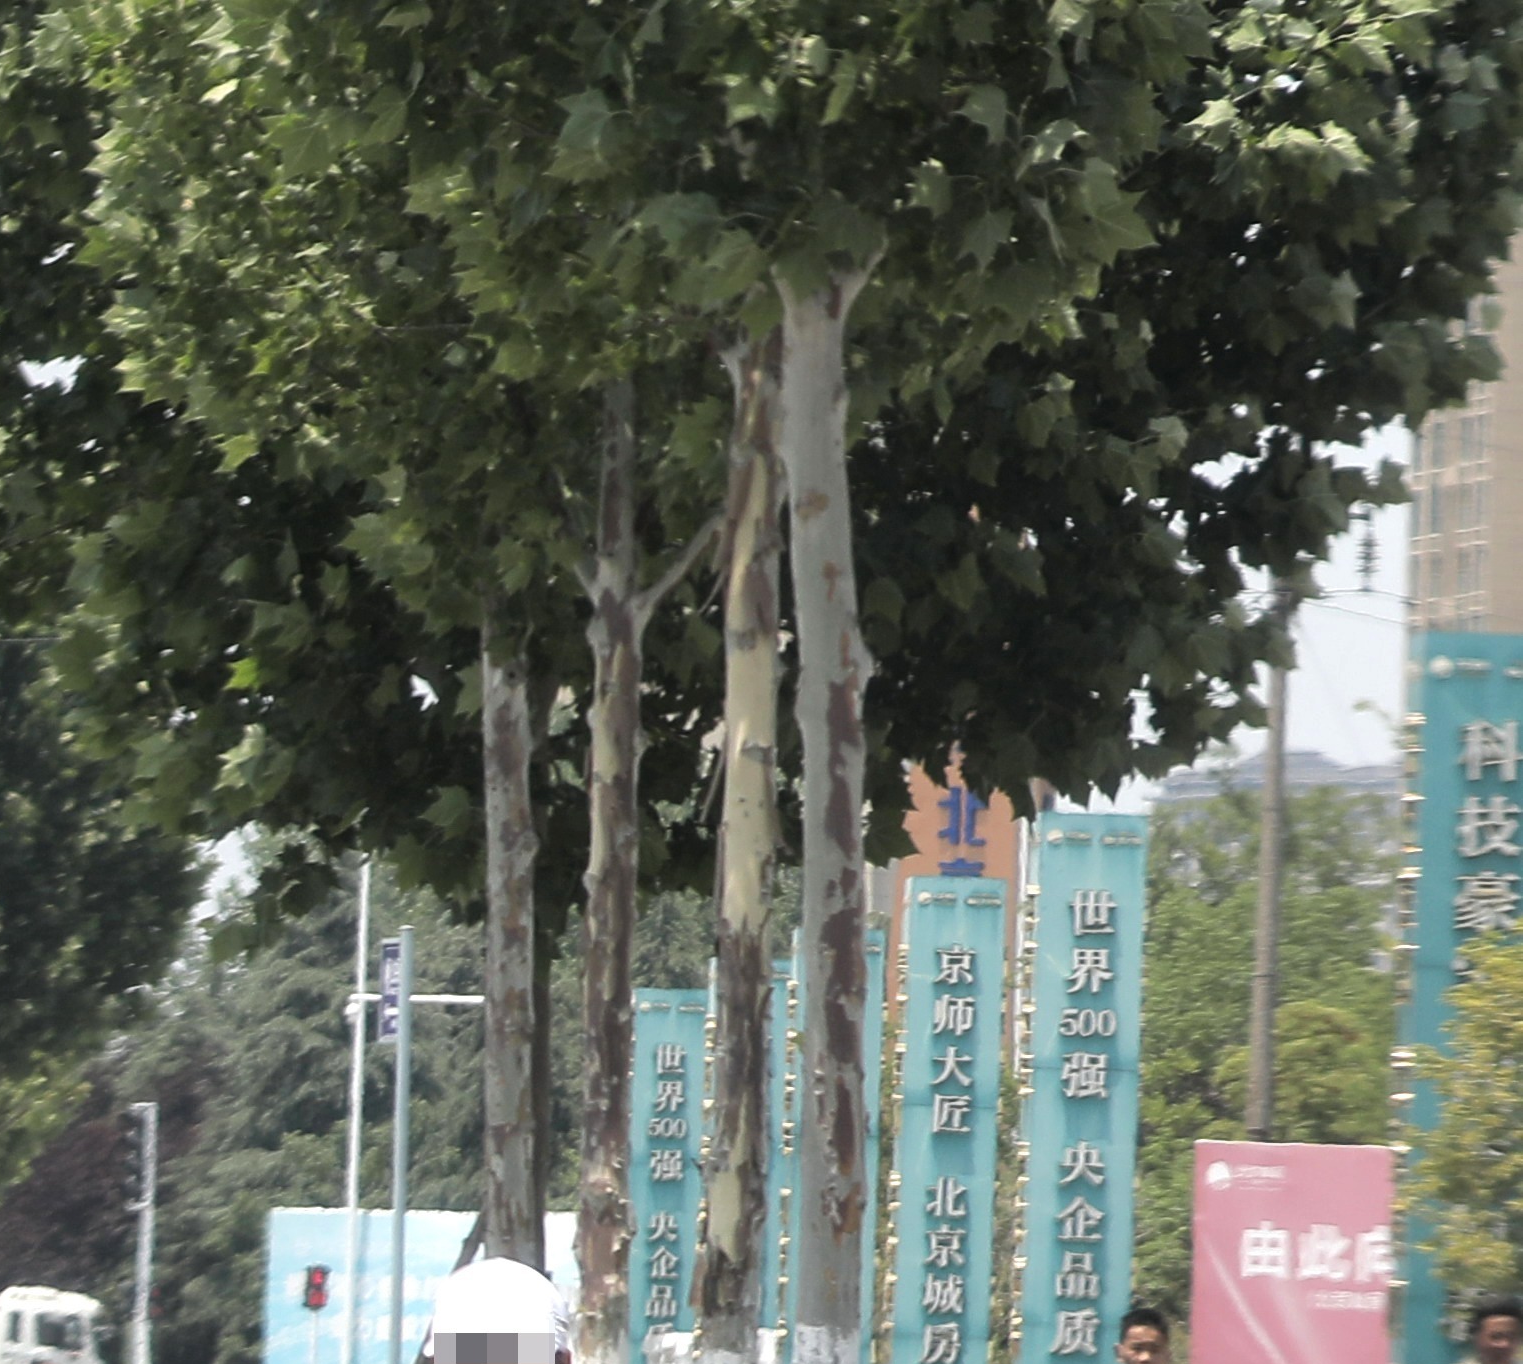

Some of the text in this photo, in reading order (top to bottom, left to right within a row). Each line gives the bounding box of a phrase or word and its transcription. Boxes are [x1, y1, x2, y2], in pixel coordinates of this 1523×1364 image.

[930, 943, 977, 1134] 京师大匠
[1058, 888, 1117, 1099] 世界500强
[647, 1043, 688, 1183] 世界500强
[643, 1210, 681, 1334] 央企品
[1049, 1139, 1106, 1357] 央企品质
